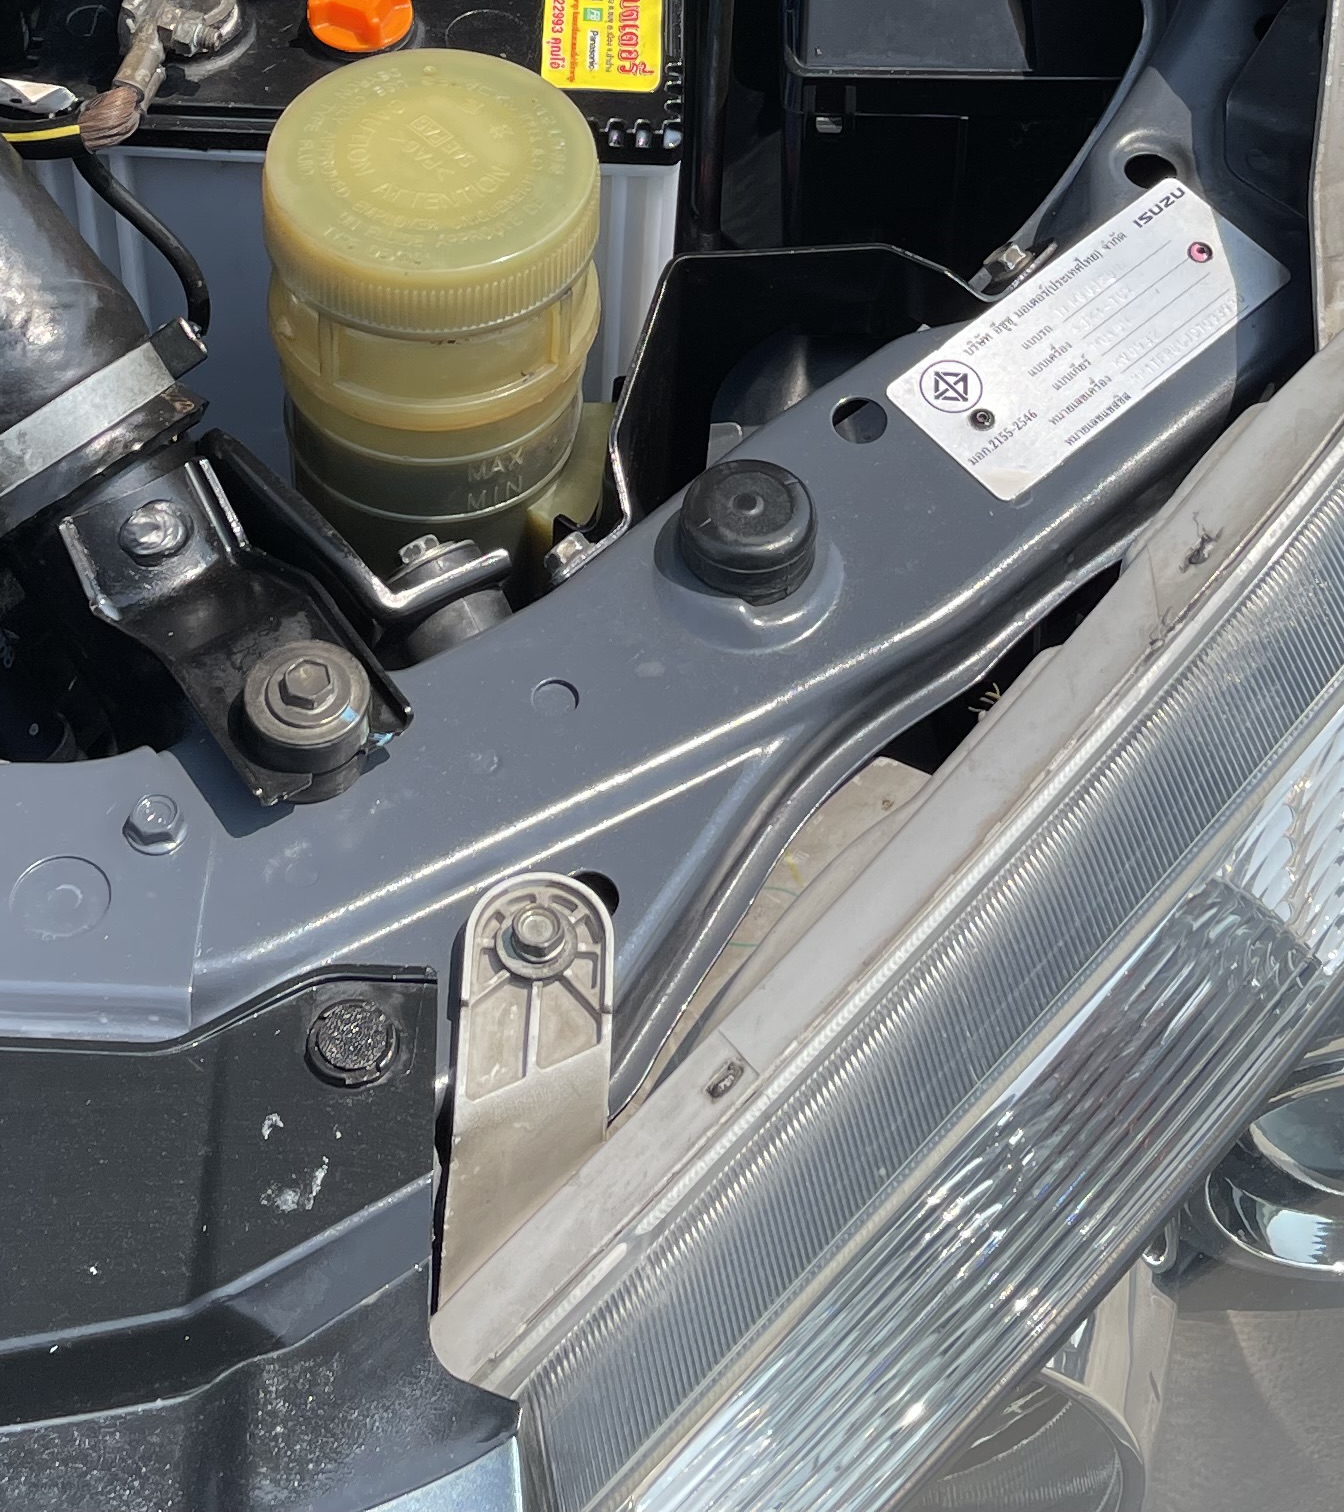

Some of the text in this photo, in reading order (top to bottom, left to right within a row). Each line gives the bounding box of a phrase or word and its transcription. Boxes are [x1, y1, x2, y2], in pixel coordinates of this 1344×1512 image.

[588, 30, 599, 70] Panasonic
[372, 164, 512, 210] ATTENTION
[1131, 187, 1187, 229] ISUZU
[967, 408, 1039, 467] มอก.2155-2546
[468, 446, 523, 483] MAX
[467, 475, 523, 511] MIN
